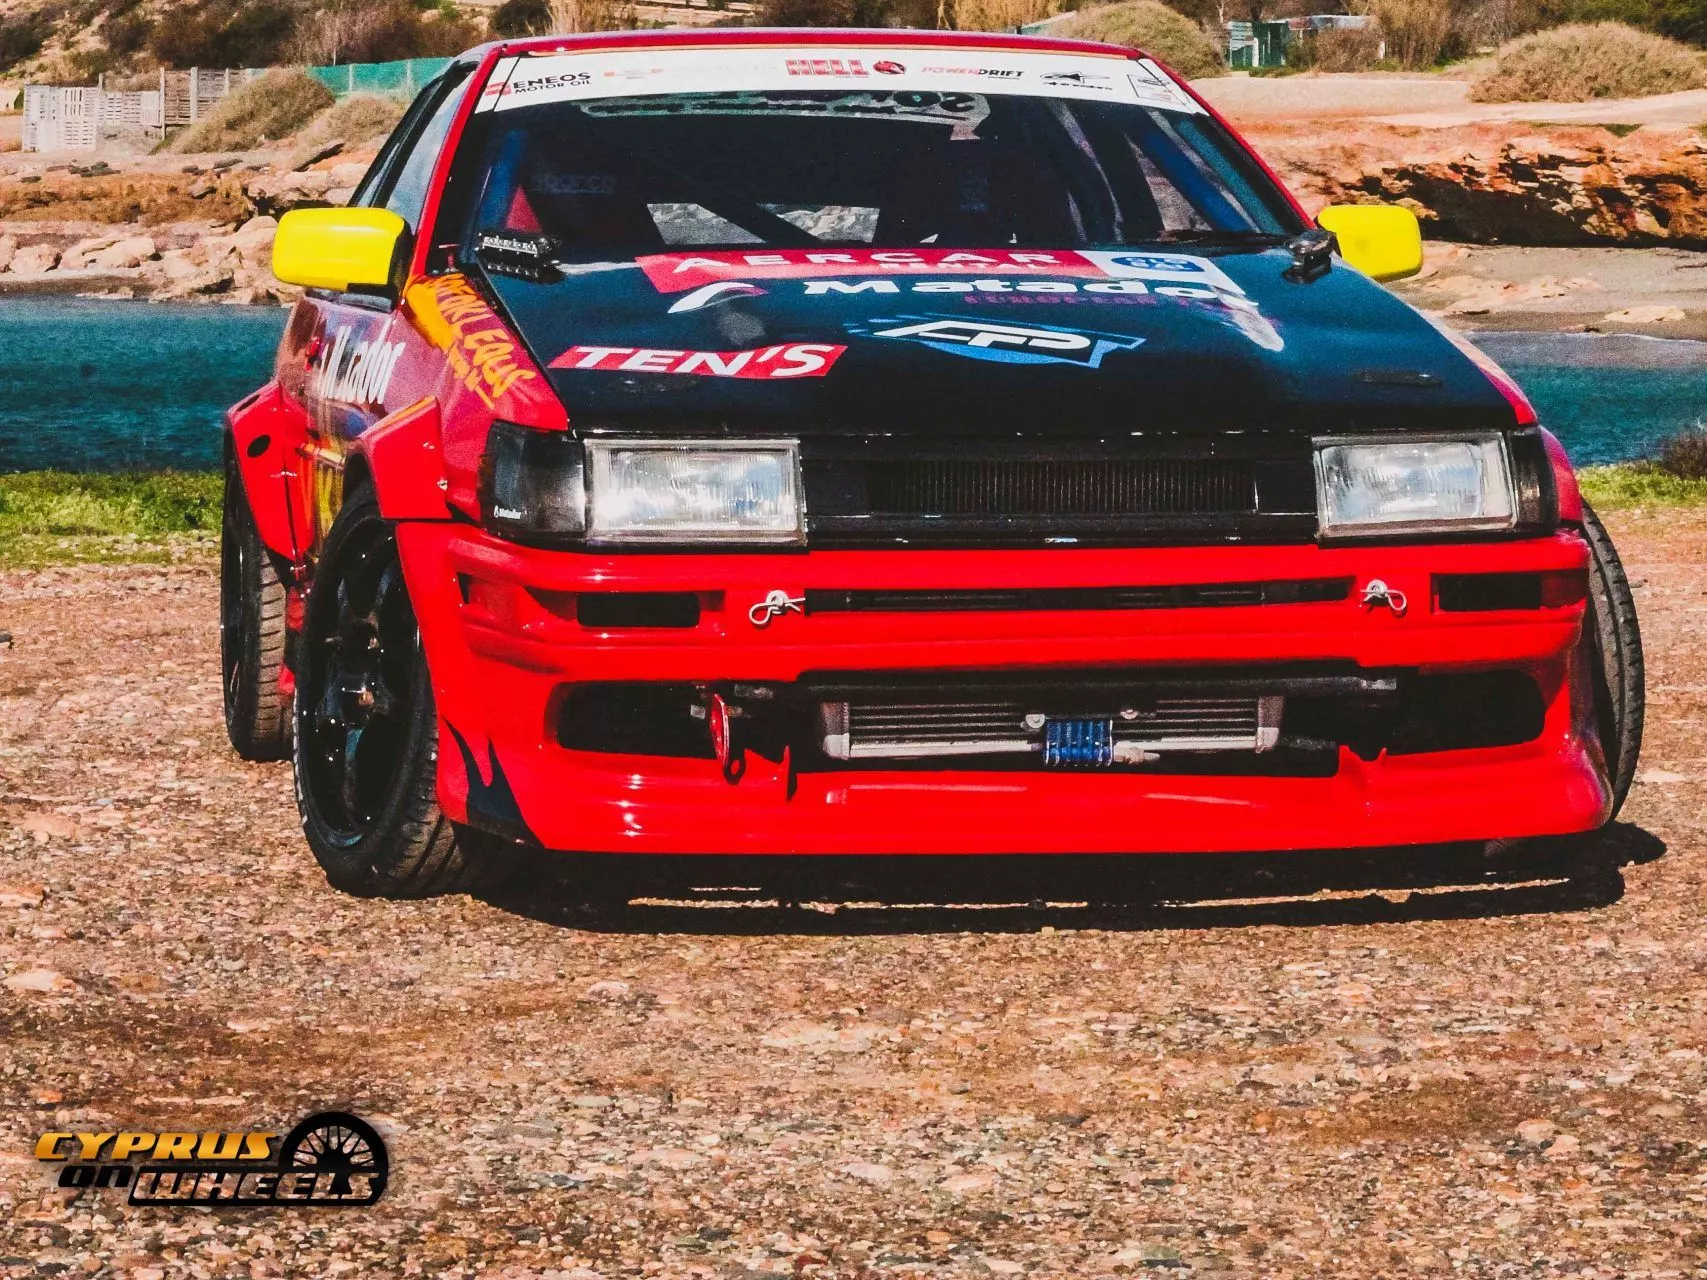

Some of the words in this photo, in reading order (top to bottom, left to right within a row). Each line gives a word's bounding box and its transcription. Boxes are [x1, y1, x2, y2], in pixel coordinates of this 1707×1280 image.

[786, 59, 869, 75] HELL
[513, 72, 591, 89] ENEOS
[515, 82, 564, 94] MOTOR
[673, 252, 1062, 273] AERCAR
[575, 344, 835, 377] TEN'S
